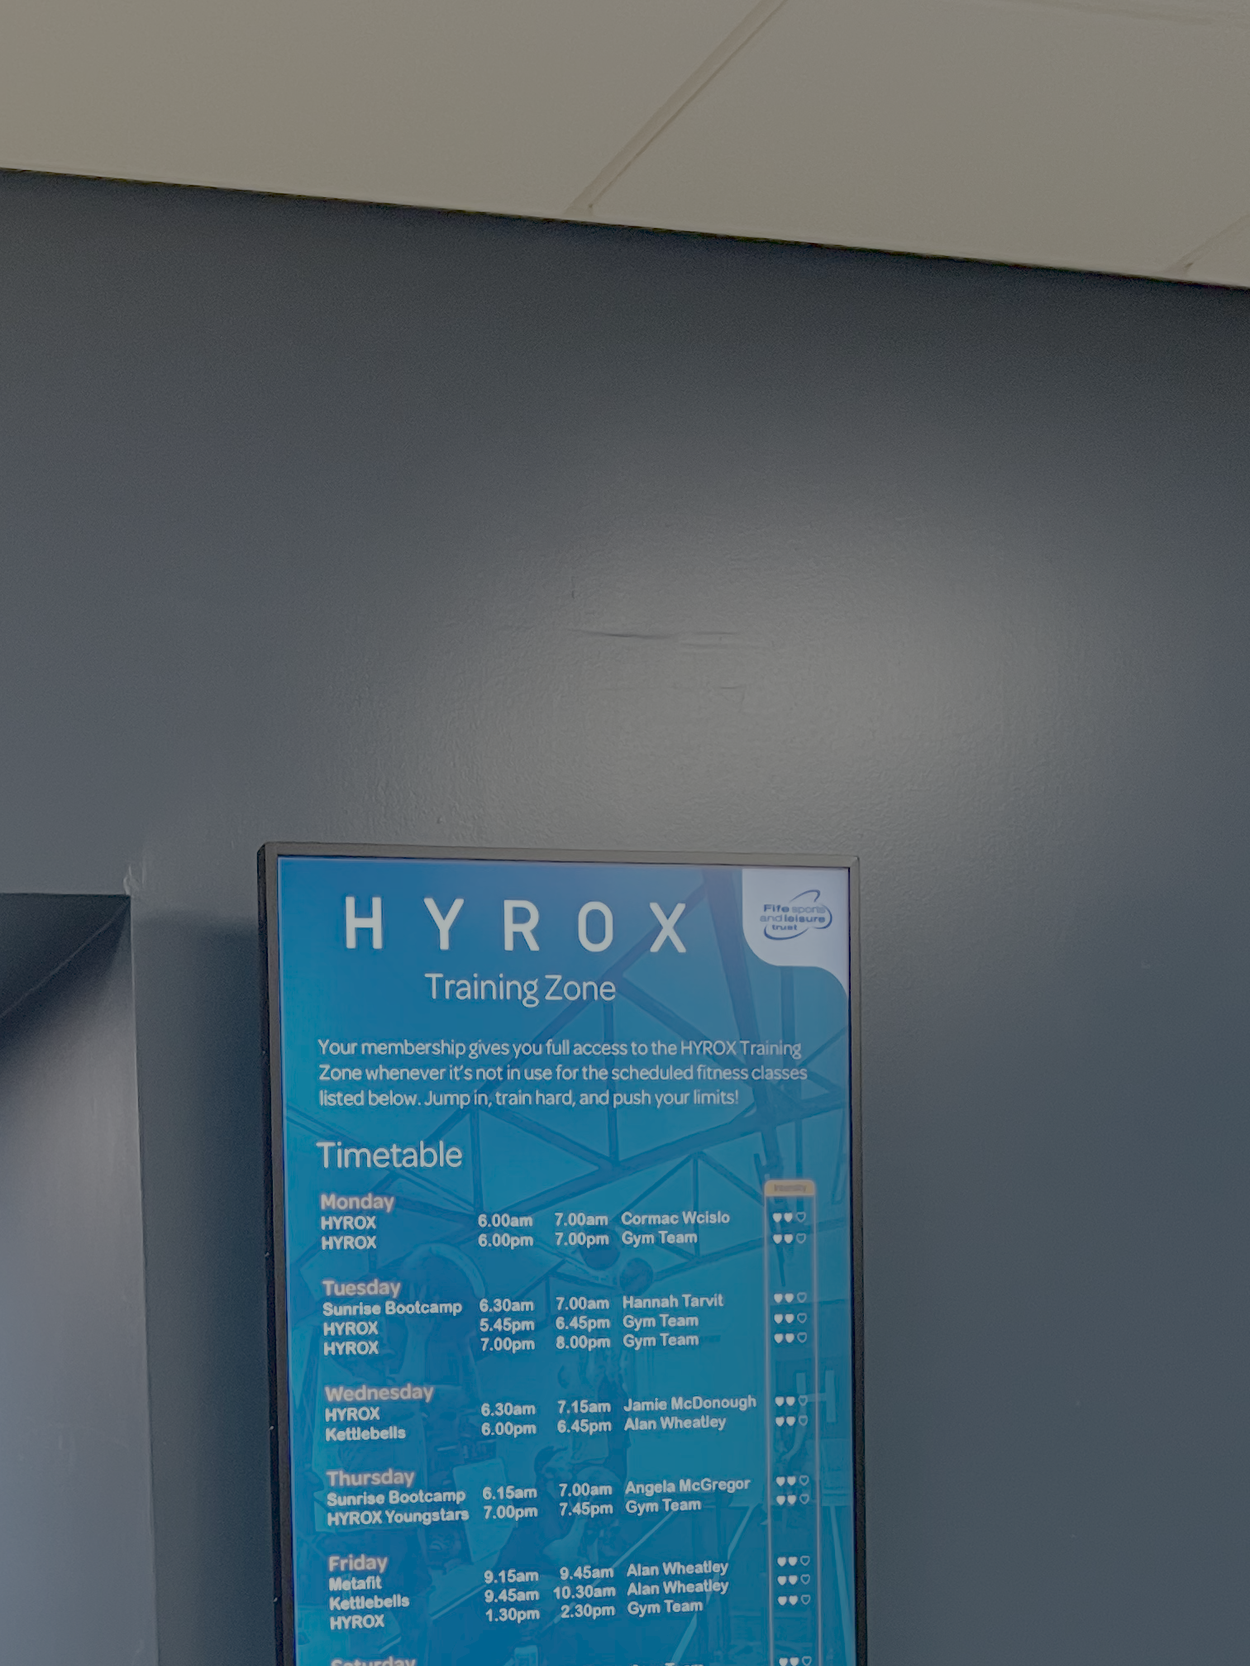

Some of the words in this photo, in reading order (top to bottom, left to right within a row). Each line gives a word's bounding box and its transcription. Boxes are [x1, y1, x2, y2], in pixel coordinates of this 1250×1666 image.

[764, 904, 789, 912] Fife
[792, 905, 825, 914] sports
[424, 972, 540, 1008] Training
[544, 974, 616, 1001] Zone
[317, 1038, 359, 1056] Your
[360, 1038, 467, 1059] membership
[468, 1039, 510, 1060] gives
[512, 1042, 543, 1059] you
[545, 1038, 570, 1056] full
[572, 1042, 629, 1056] access
[630, 1041, 649, 1056] to
[650, 1039, 678, 1056] the
[680, 1039, 737, 1056] HYROX
[739, 1039, 802, 1060] Training
[318, 1063, 363, 1081] Zone
[364, 1064, 447, 1081] whenever
[475, 1065, 504, 1081] not
[506, 1063, 521, 1081] in
[523, 1068, 553, 1081] use
[555, 1063, 580, 1081] for
[581, 1064, 609, 1081] the
[611, 1064, 694, 1081] scheduled
[696, 1063, 749, 1081] fitness
[751, 1064, 808, 1081] classes
[319, 1089, 365, 1107] listed
[368, 1089, 422, 1107] below.
[423, 1090, 471, 1110] Jump
[473, 1088, 493, 1108] in,
[494, 1089, 533, 1106] train
[535, 1089, 576, 1108] hard,
[579, 1089, 610, 1106] and
[613, 1089, 652, 1109] push
[654, 1092, 691, 1109] your
[693, 1088, 739, 1105] limits!
[315, 1139, 463, 1169] Timetable
[320, 1192, 395, 1214] Monday
[320, 1215, 377, 1231] HYROX
[477, 1212, 534, 1228] 6.00am
[554, 1212, 609, 1227] 7.00am
[620, 1211, 680, 1226] Cormac
[681, 1210, 731, 1225] Wcislo
[321, 1235, 377, 1251] HYROX
[477, 1232, 534, 1251] 6.00pm
[554, 1231, 610, 1249] 7.00pm
[621, 1230, 655, 1249] Gym
[657, 1230, 698, 1244] Team
[321, 1278, 402, 1299] Tuesday
[322, 1301, 382, 1317] Sunrise
[384, 1300, 463, 1317] Bootcamp
[479, 1297, 535, 1313] 6.30am
[555, 1296, 610, 1311] 7.00am
[622, 1293, 679, 1310] Hannah
[681, 1293, 725, 1308] Tarvit
[323, 1320, 379, 1337] HYROX
[479, 1316, 535, 1335] 5.45pm
[555, 1315, 611, 1333] 6.45pm
[622, 1314, 657, 1332] Gym
[658, 1313, 699, 1328] Team
[323, 1340, 380, 1356] HYROX
[480, 1336, 536, 1355] 7.00pm
[555, 1334, 611, 1352] 8.00pm
[622, 1333, 657, 1351] Gym
[659, 1332, 700, 1347] Team
[324, 1382, 435, 1404] Wednesday
[324, 1406, 381, 1423] HYROX
[480, 1401, 536, 1417] 6.30am
[557, 1399, 612, 1414] 7.15am
[623, 1397, 668, 1412] Jamie
[670, 1394, 757, 1412] McDonough
[325, 1425, 407, 1442] Kettlebells
[481, 1421, 537, 1439] 6.00pm
[556, 1418, 612, 1436] 6.45pm
[623, 1417, 658, 1432] Alan
[659, 1414, 727, 1432] Wheatley
[325, 1467, 416, 1489] Thursday
[326, 1491, 386, 1507] Sunrise
[388, 1488, 467, 1505] Bootcamp
[482, 1485, 538, 1501] 6.15am
[558, 1482, 613, 1498] 7.00am
[624, 1479, 676, 1497] Angela
[678, 1477, 752, 1494] McGregor
[327, 1510, 383, 1527] HYROX
[384, 1507, 470, 1526] Youngstars
[483, 1504, 539, 1522] 7.00pm
[558, 1501, 614, 1519] 7.45pm
[624, 1499, 660, 1517] Gym
[661, 1498, 702, 1512] Team
[327, 1553, 389, 1574] Friday
[328, 1575, 383, 1592] Metafit
[483, 1568, 540, 1585] 9.15am
[559, 1564, 615, 1581] 9.45am
[626, 1562, 660, 1578] Alan
[662, 1559, 729, 1577] Wheatley
[328, 1593, 410, 1611] Kettlebells
[484, 1587, 540, 1604] 9.45am
[552, 1584, 617, 1600] 10.30am
[626, 1581, 660, 1597] Alan
[662, 1578, 730, 1595] Wheatley
[329, 1613, 385, 1631] HYROX
[485, 1607, 541, 1624] 1.30pm
[560, 1602, 616, 1621] 2.30pm
[626, 1600, 661, 1618] Gym
[663, 1599, 704, 1613] Team
